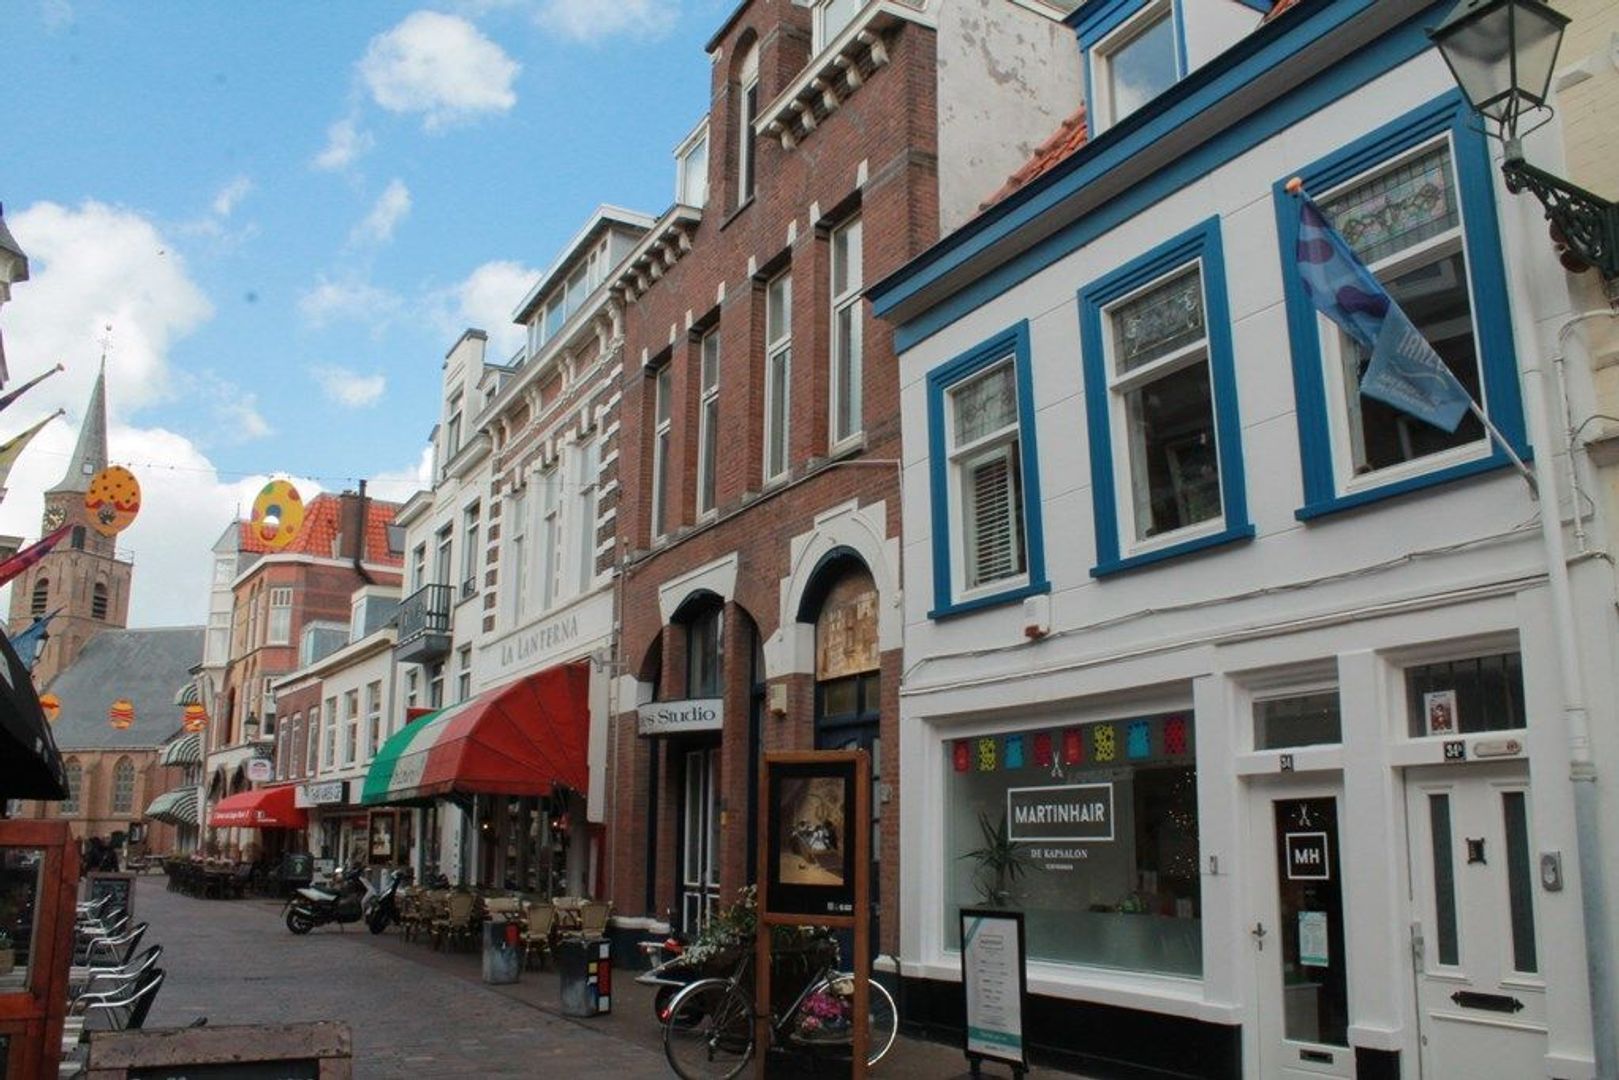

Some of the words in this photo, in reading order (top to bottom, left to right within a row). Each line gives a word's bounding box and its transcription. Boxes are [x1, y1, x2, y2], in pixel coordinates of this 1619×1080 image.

[518, 614, 578, 660] LANTERNA
[657, 706, 716, 724] Studio
[1015, 803, 1105, 824] MARTINHAIR
[1030, 848, 1042, 859] DE
[1044, 848, 1088, 859] KAPSALON
[1294, 848, 1320, 865] MH
